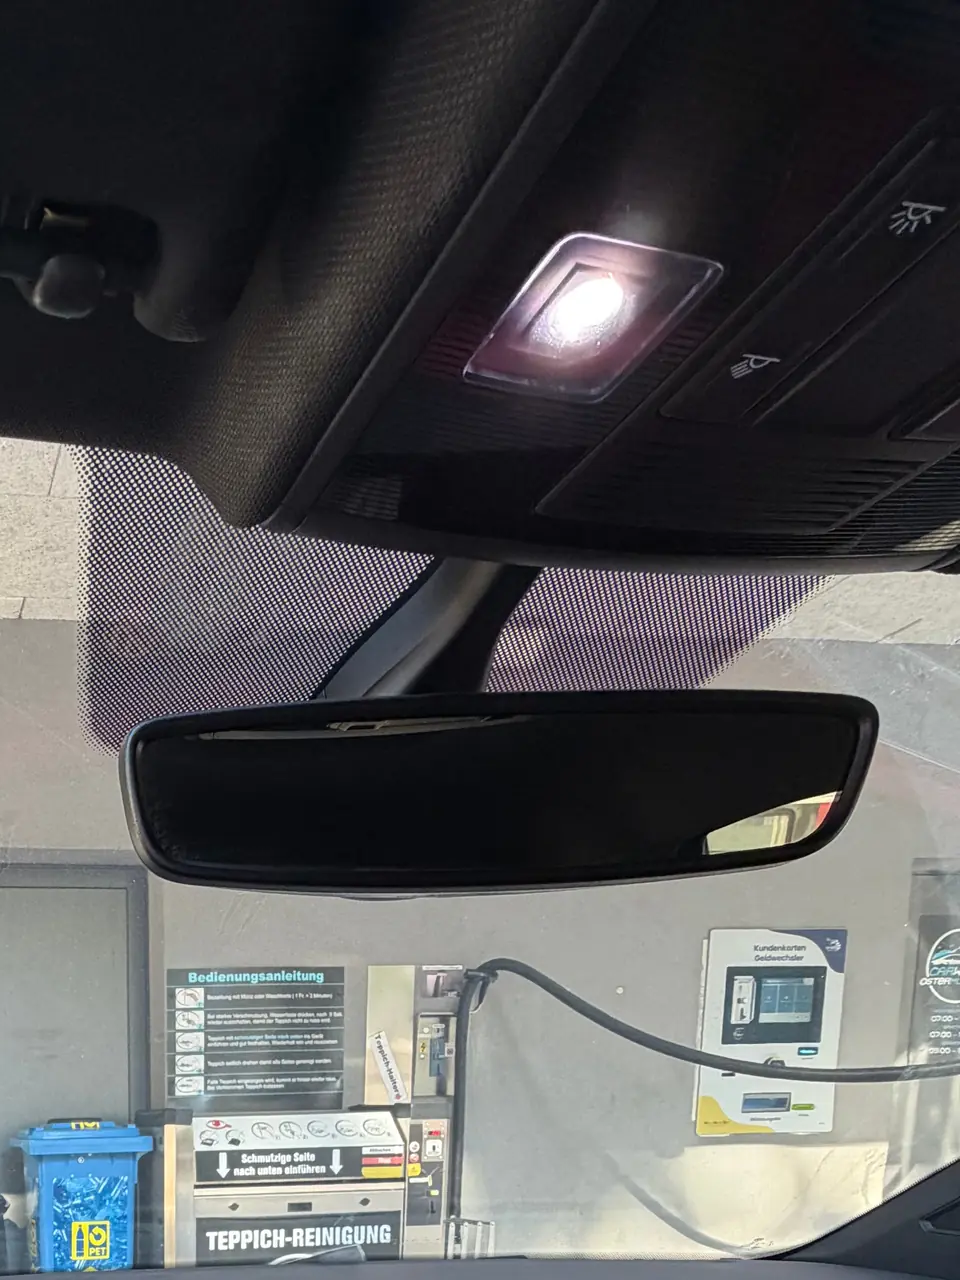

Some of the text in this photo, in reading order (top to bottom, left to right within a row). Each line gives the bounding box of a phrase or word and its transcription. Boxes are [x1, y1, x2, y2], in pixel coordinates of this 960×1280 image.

[754, 944, 806, 952] Kundenkarten
[754, 954, 804, 962] Geldwechsler
[188, 970, 324, 984] Bedienungsanleitung
[241, 1152, 315, 1164] Schmutzige Seite
[234, 1164, 326, 1176] nach unten einführen
[206, 1224, 391, 1251] TEPPICH-REINIGUNG
[90, 1247, 106, 1256] PET
